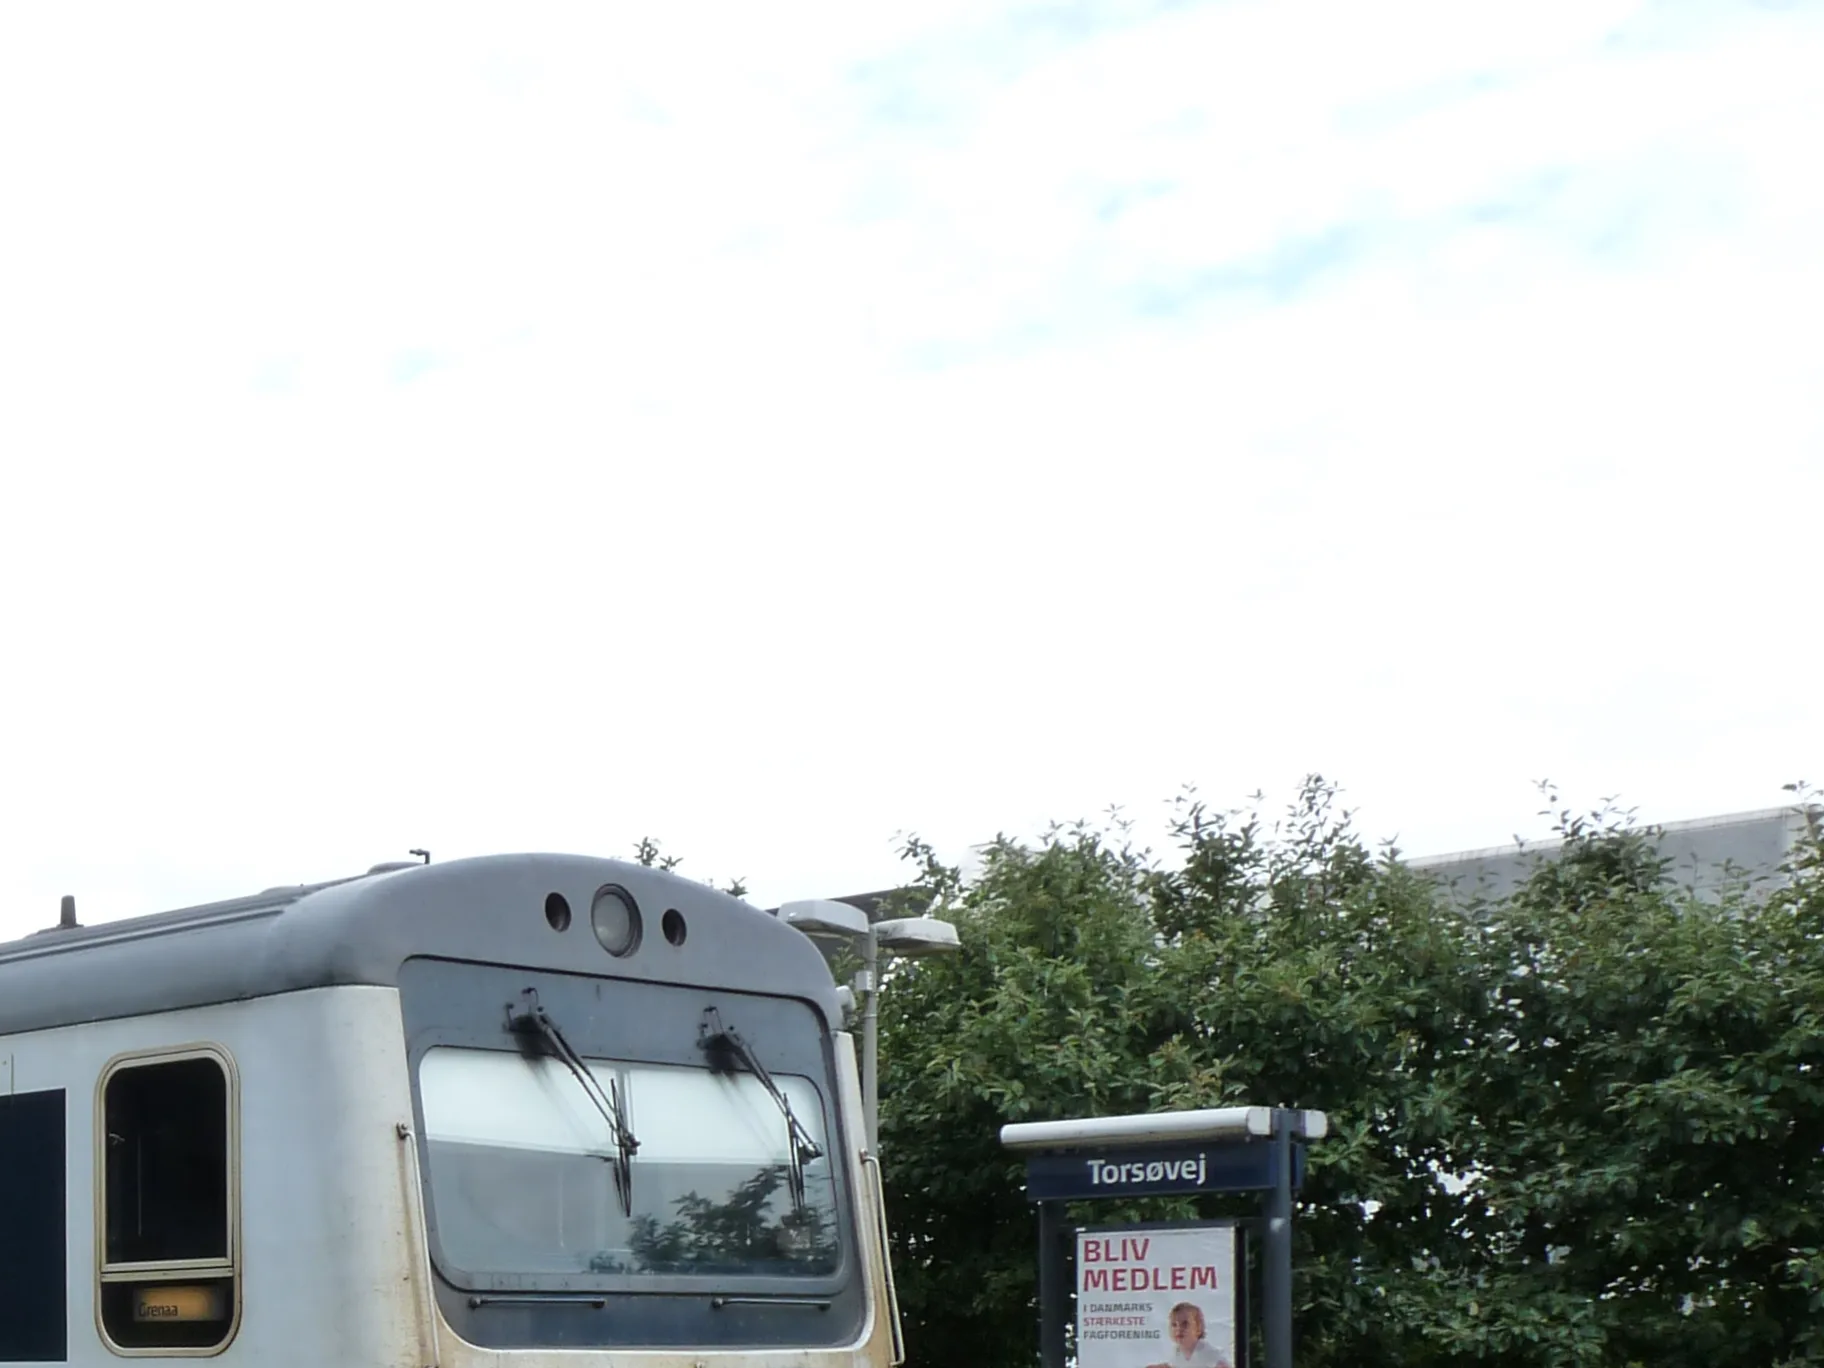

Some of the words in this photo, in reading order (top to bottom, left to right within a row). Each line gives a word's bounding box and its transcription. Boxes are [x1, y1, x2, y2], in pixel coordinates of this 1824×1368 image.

[1087, 1152, 1206, 1185] Torsøvej
[1083, 1237, 1150, 1263] BLIV
[1083, 1266, 1218, 1293] MEDLEM
[1089, 1303, 1153, 1313] DANMARKS
[1083, 1317, 1145, 1326] STÆRKESTE
[1083, 1330, 1160, 1340] FAGFORENING
